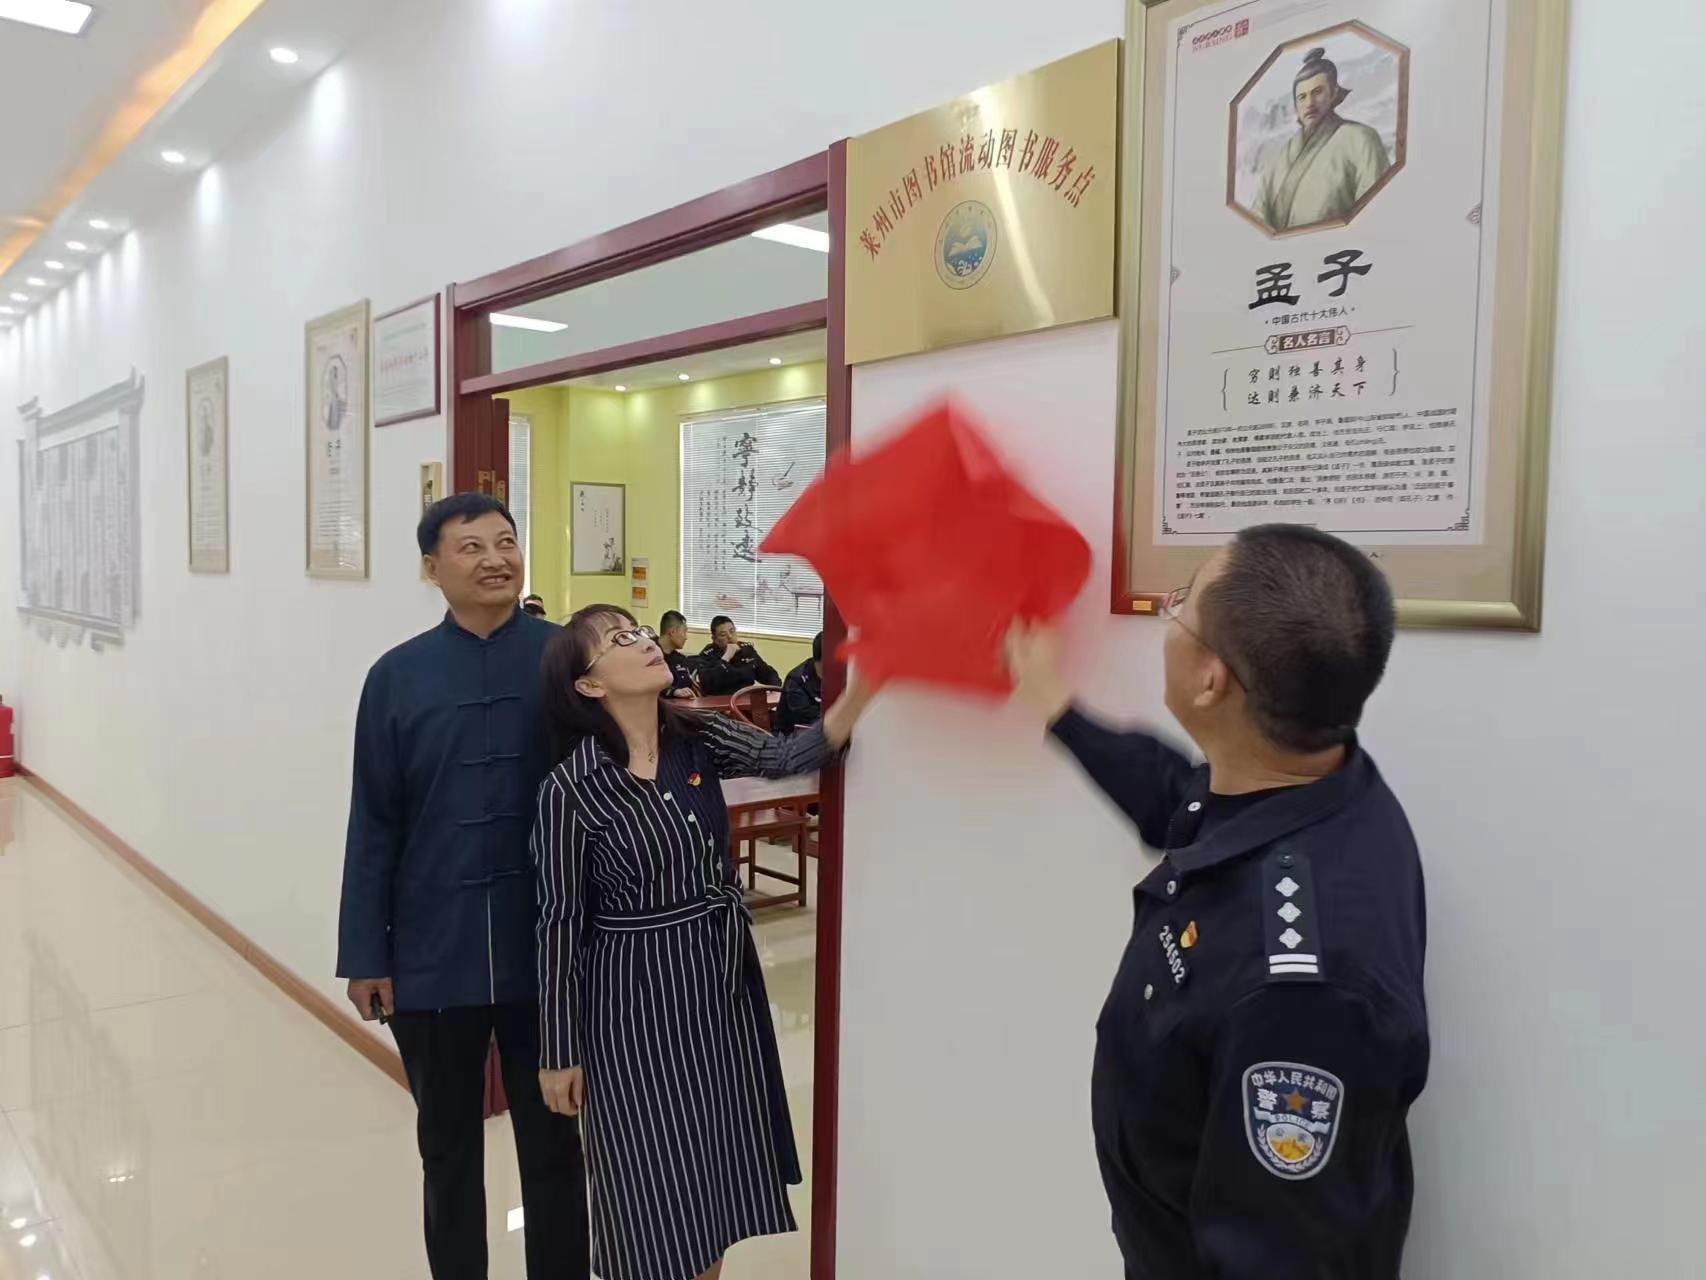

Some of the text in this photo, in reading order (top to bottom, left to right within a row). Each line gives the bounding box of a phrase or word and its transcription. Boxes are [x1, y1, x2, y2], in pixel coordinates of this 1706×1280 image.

[859, 129, 1096, 262] 莱州市图书馆流动图书服务点
[1248, 249, 1373, 310] 孟子
[1271, 307, 1348, 325] 中国古代十大伟人
[1283, 331, 1331, 349] 名人名言
[1251, 1069, 1338, 1101] 中华人民共和国
